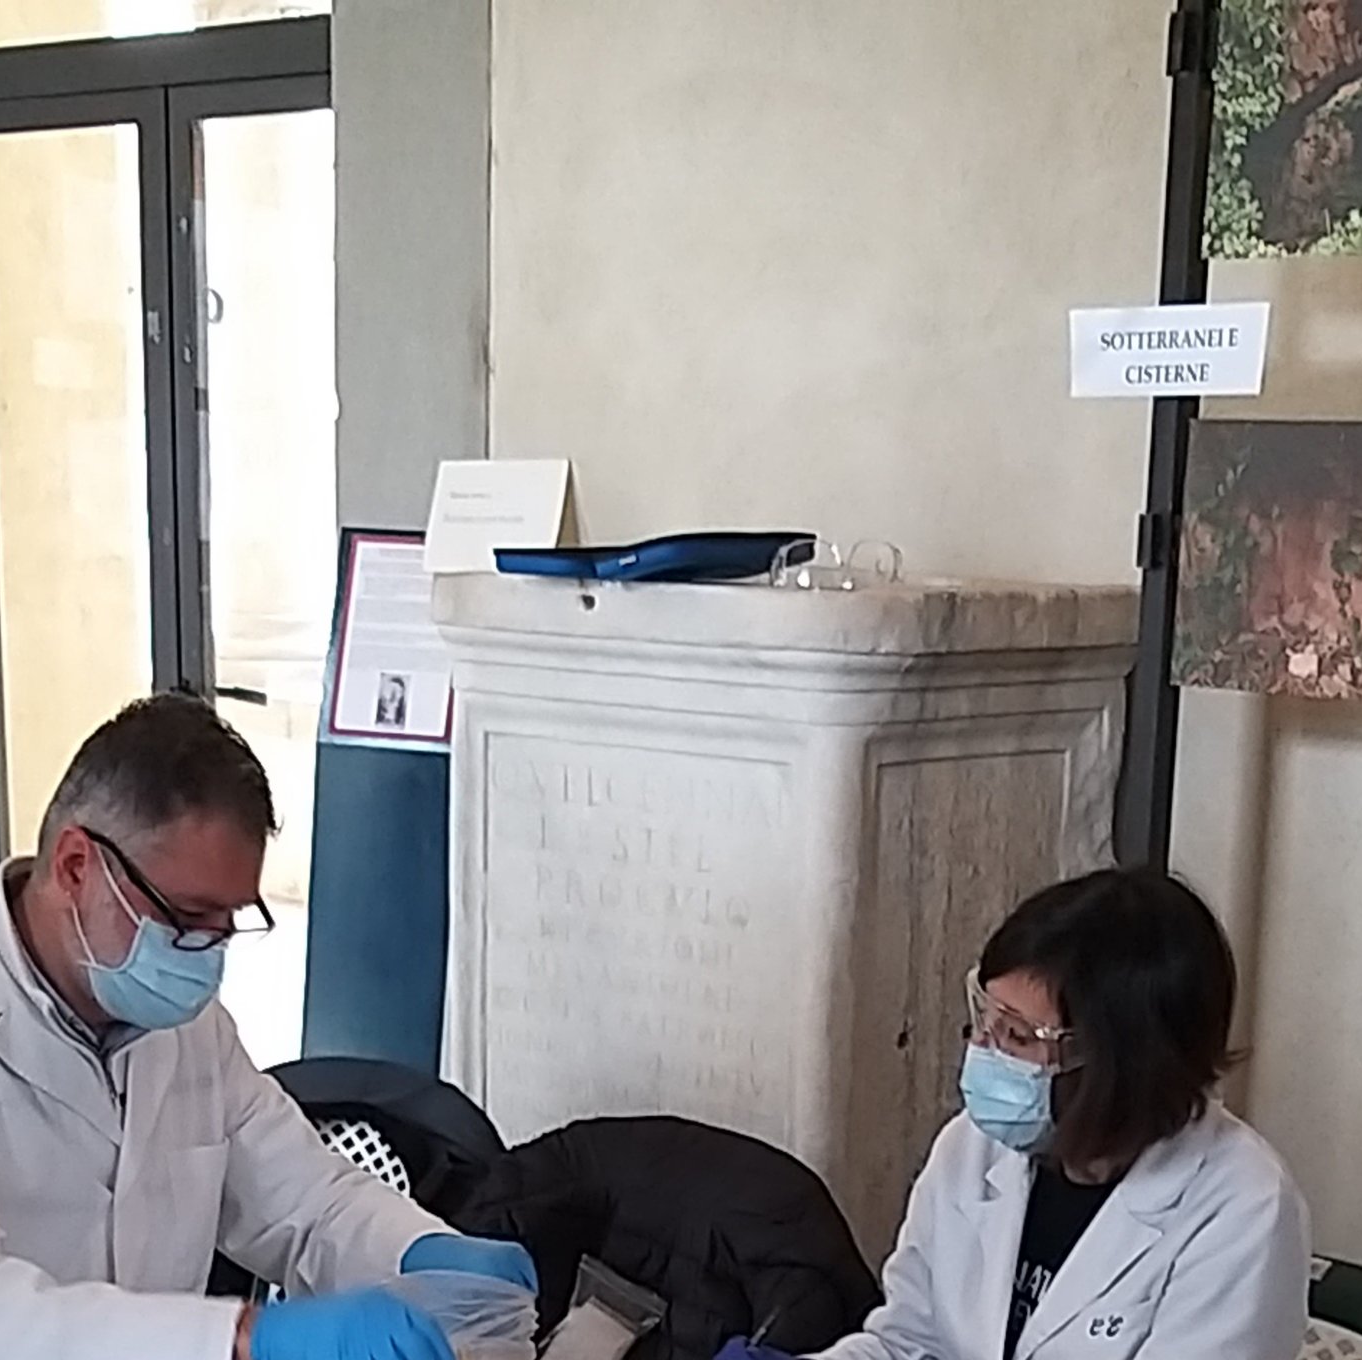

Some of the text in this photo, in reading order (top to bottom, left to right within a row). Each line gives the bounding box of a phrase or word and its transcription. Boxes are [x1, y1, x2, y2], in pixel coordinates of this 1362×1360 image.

[1100, 327, 1239, 351] SOTTERRANEI E
[1124, 362, 1211, 385] CISTERNE
